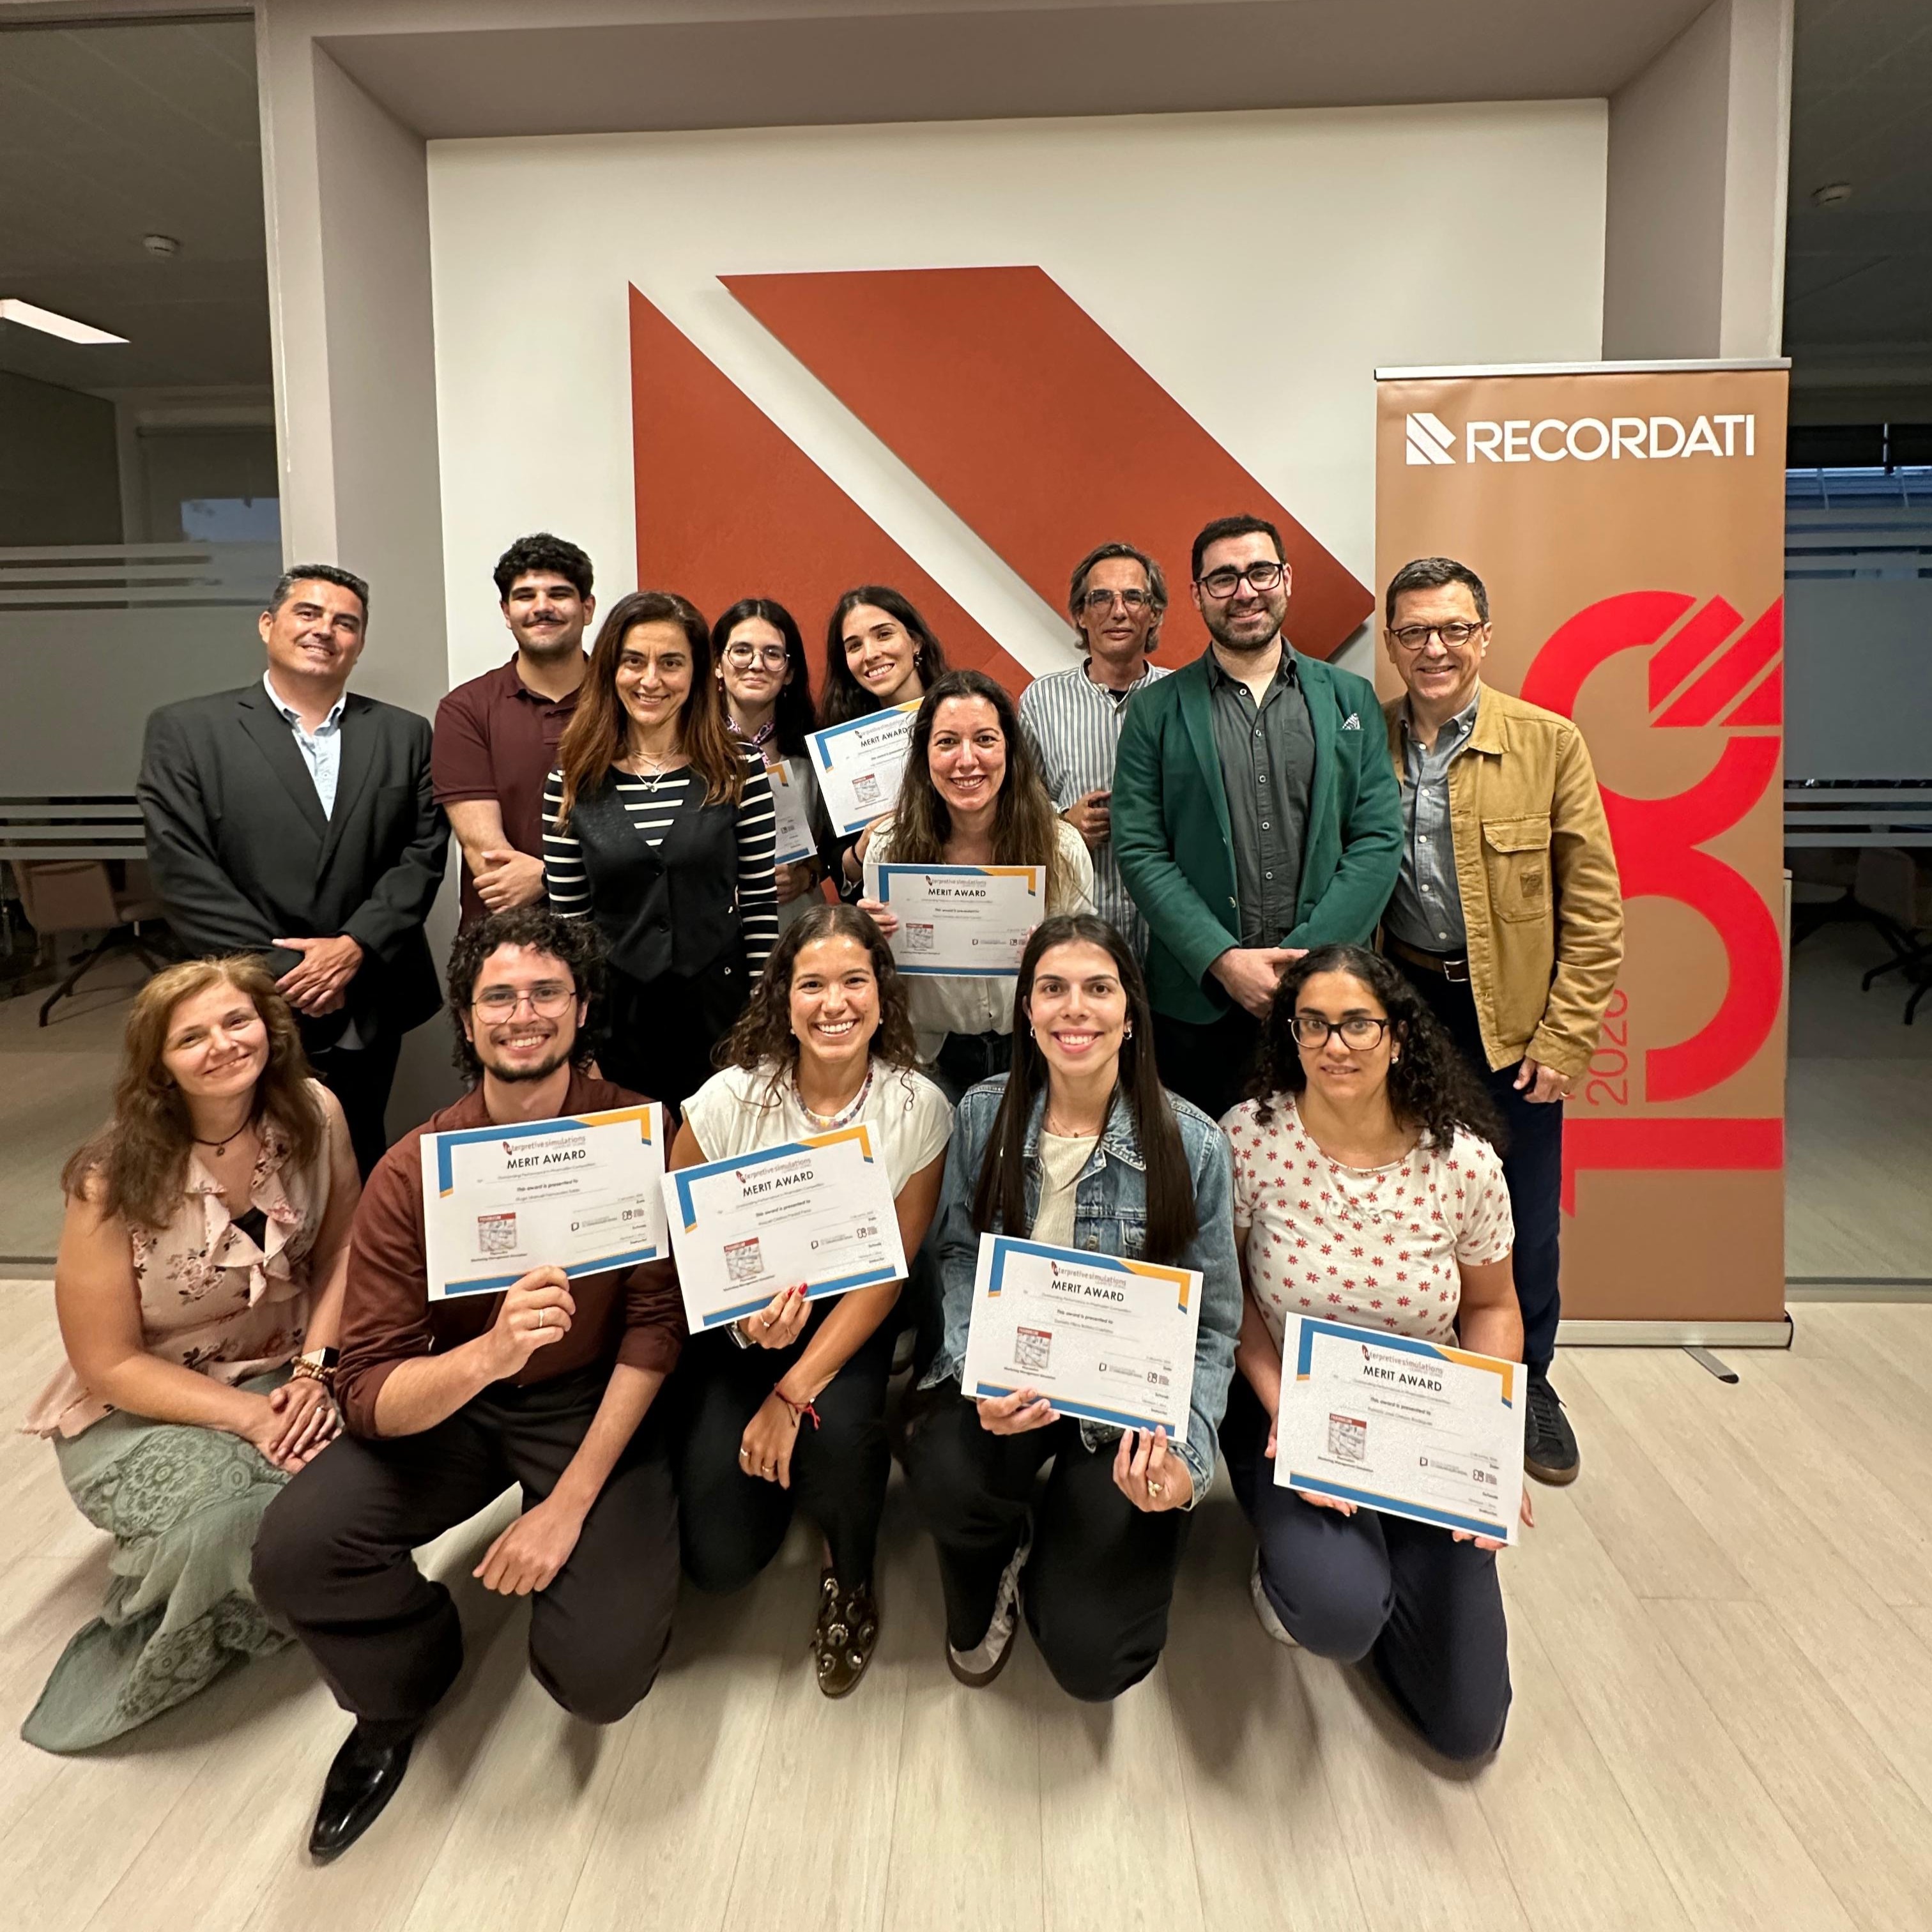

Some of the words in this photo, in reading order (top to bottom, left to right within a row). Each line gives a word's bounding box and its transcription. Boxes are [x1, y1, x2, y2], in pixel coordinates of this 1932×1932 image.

[1467, 415, 1755, 463] RECORDATI
[861, 736, 880, 747] MERIT
[882, 727, 908, 740] AWARD
[954, 889, 986, 897] AWARD
[507, 1156, 539, 1169] MERIT
[542, 1149, 586, 1165] AWARD
[743, 1181, 771, 1197] MERIT
[775, 1170, 813, 1188] AWARD
[1052, 1280, 1082, 1294] MERIT
[1084, 1286, 1124, 1301] AWARD
[1363, 1365, 1396, 1381] MERIT
[1399, 1373, 1442, 1392] AWARD
